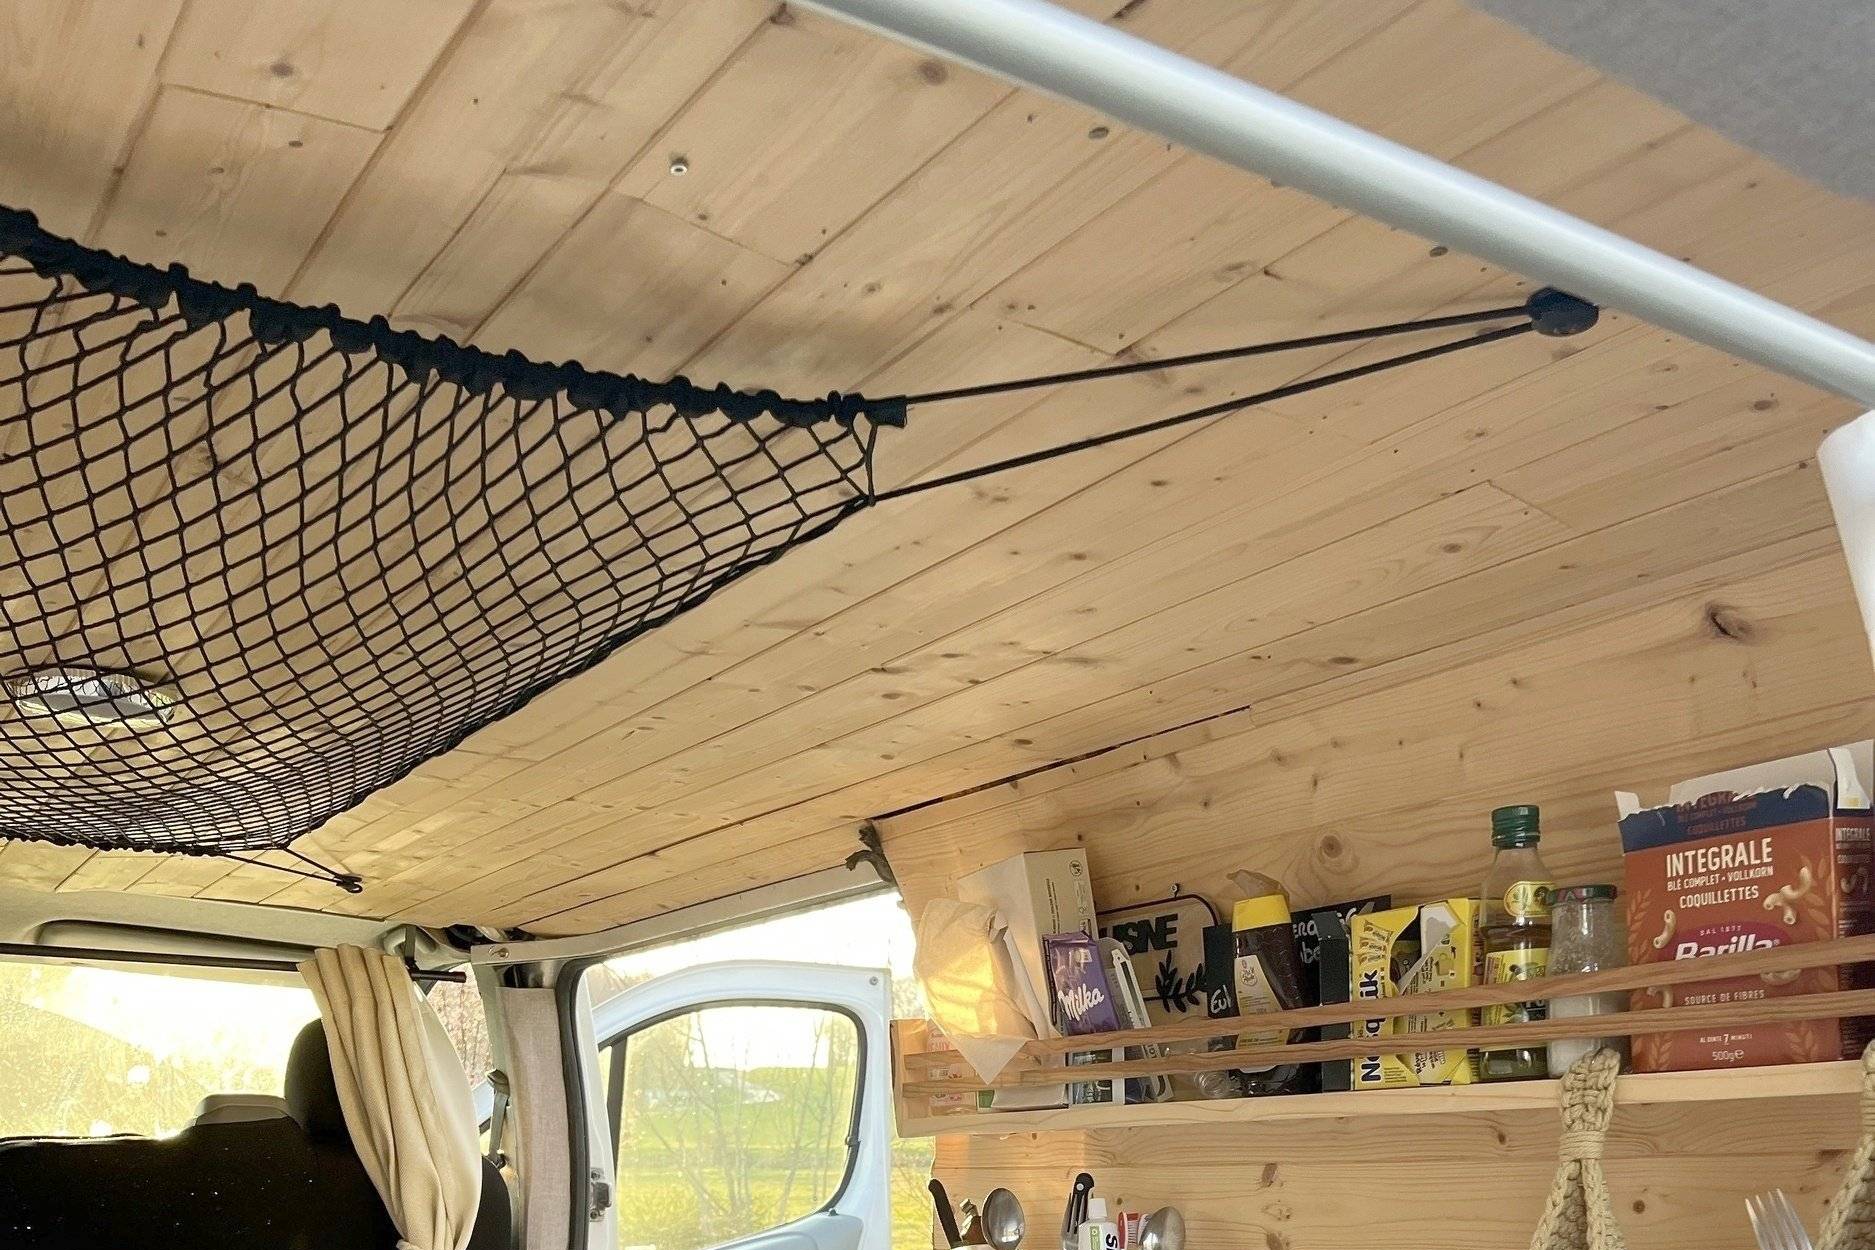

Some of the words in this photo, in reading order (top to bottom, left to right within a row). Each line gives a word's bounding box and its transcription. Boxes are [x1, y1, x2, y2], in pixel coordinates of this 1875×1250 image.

[1665, 837, 1773, 878] INTEGRALE
[1683, 873, 1721, 889] COMPLET
[1727, 865, 1774, 882] VOLLKORN
[1679, 885, 1759, 909] COQUILLETTES
[1058, 983, 1105, 1022] Milka
[1684, 991, 1717, 1006] SOURCE
[1720, 991, 1730, 1003] DE
[1734, 989, 1766, 1001] FIBRES
[1723, 1033, 1730, 1046] 7
